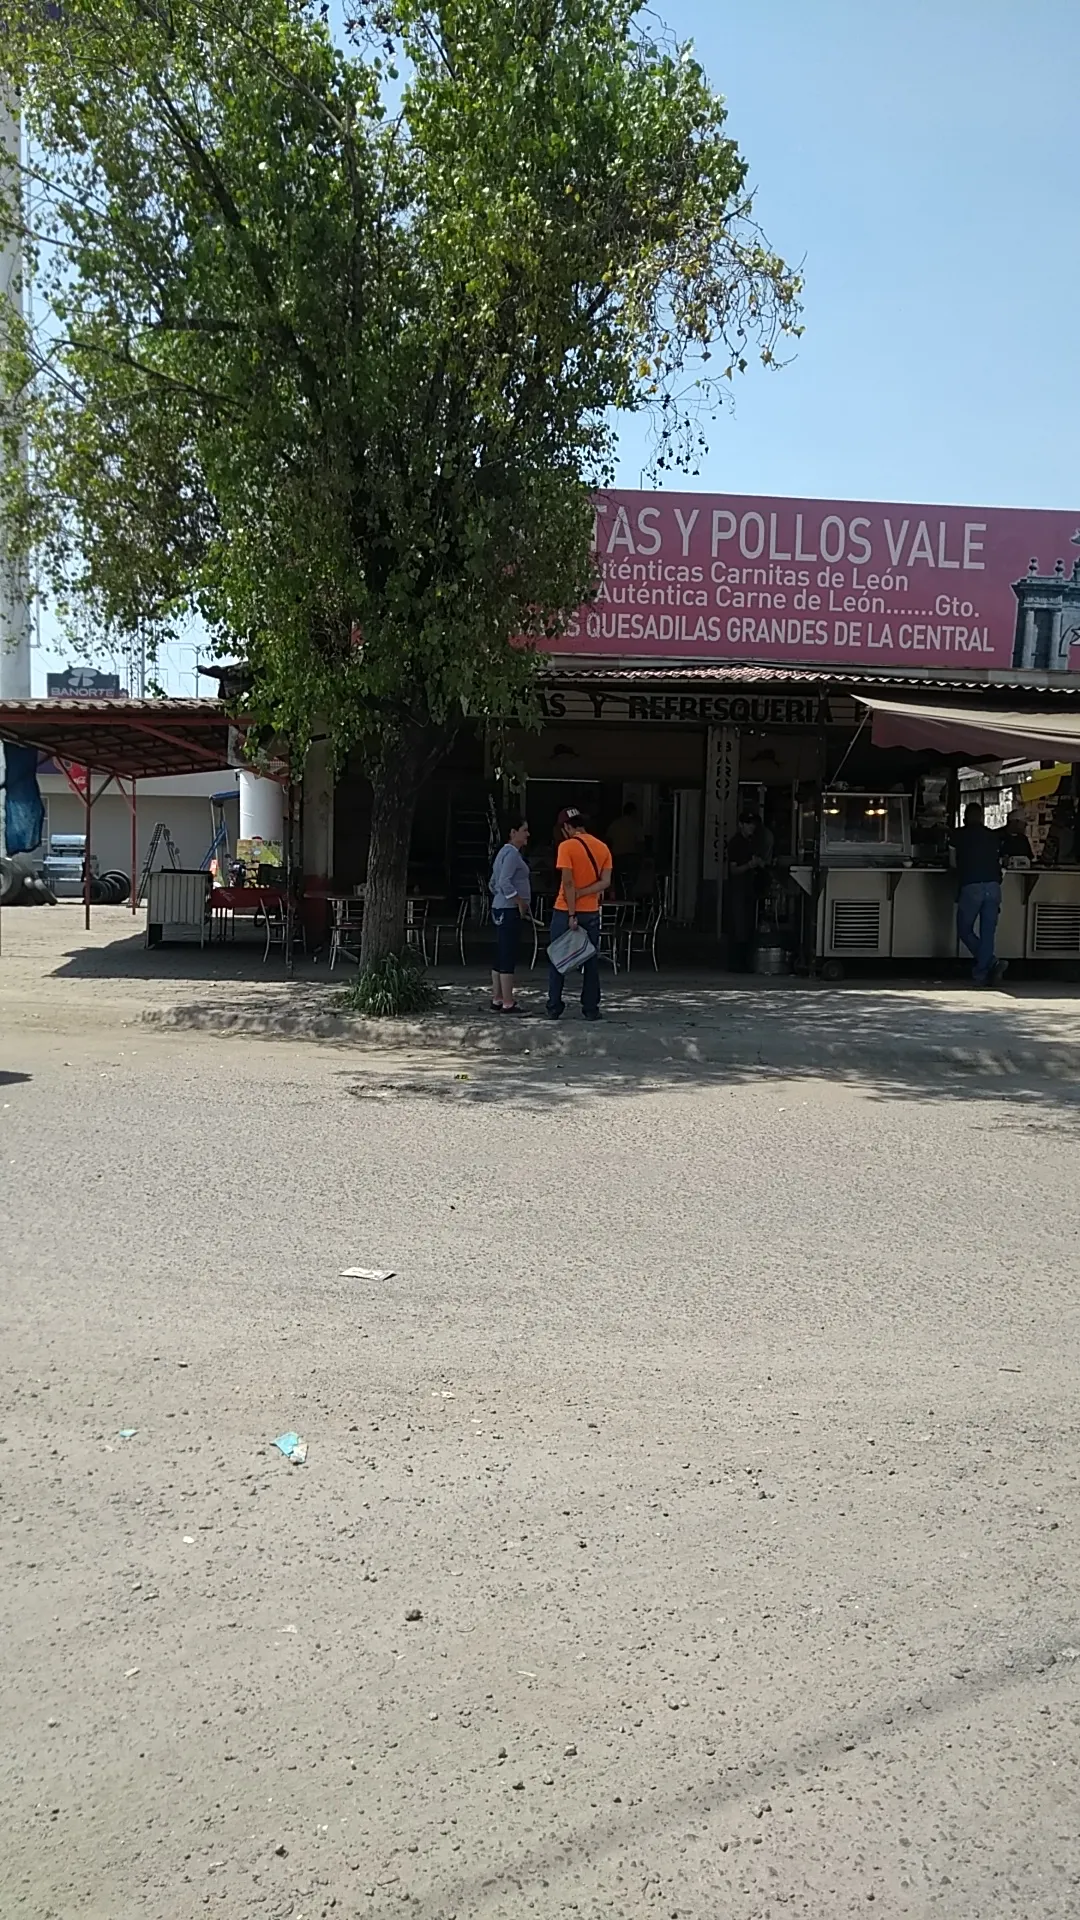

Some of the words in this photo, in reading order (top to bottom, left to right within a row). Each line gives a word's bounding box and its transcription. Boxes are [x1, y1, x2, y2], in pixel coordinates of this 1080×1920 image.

[673, 508, 700, 557] Y
[711, 509, 872, 565] POLLOS
[883, 518, 987, 570] VALE
[710, 561, 810, 587] Carnitas
[816, 565, 845, 588] de
[852, 567, 908, 592] León
[594, 580, 708, 606] Auténtica
[716, 585, 787, 609] Carne
[793, 588, 821, 611] de
[586, 612, 721, 642] QUESADILAS
[726, 617, 828, 646] GRANDES
[834, 621, 862, 647] DE
[867, 622, 894, 649] LA
[898, 624, 995, 652] CENTRAL
[51, 687, 114, 697] BANORTE
[588, 691, 605, 718] Y
[628, 695, 833, 723] REFRESQUERIA
